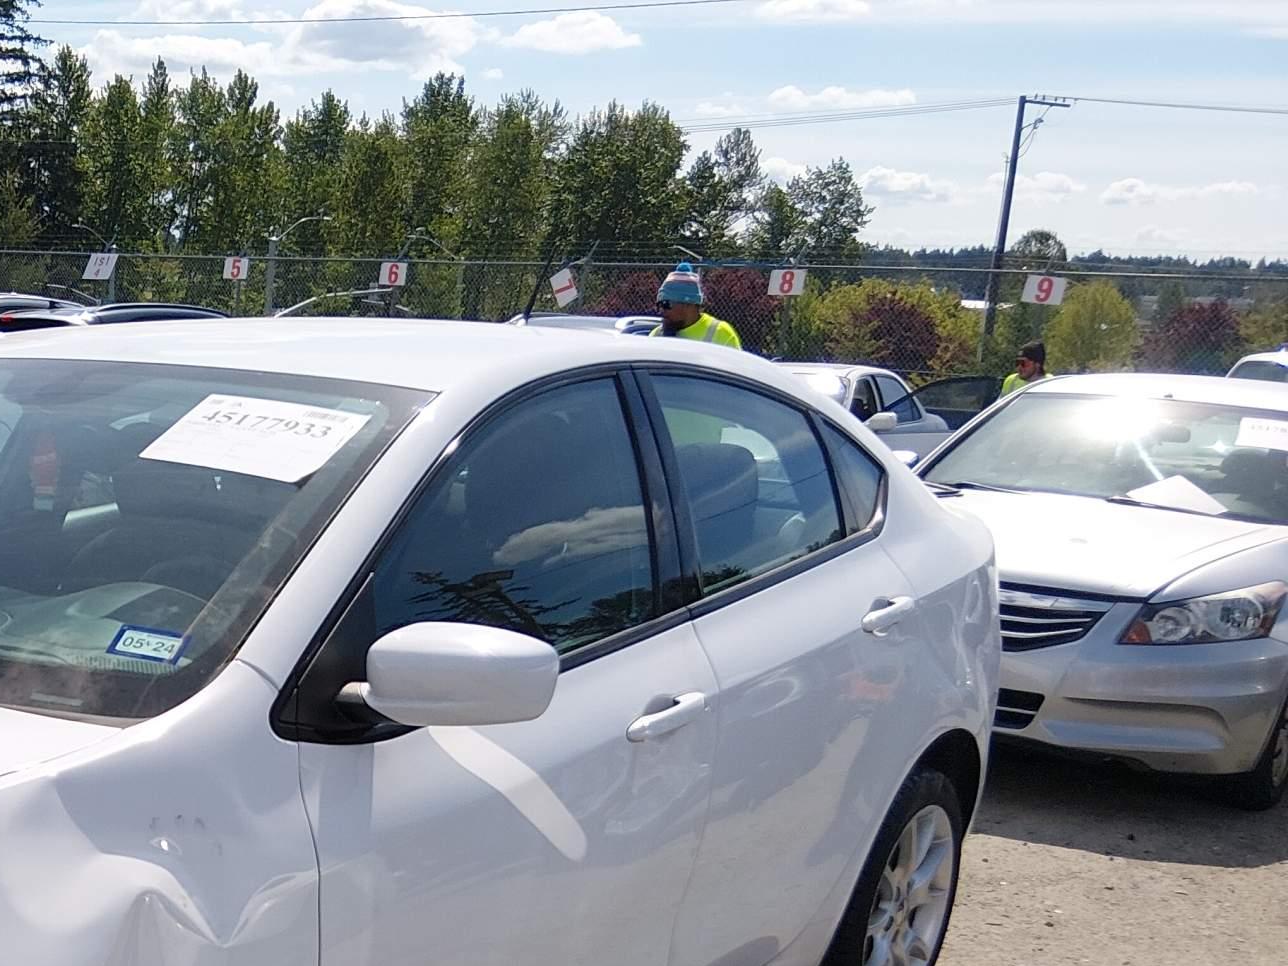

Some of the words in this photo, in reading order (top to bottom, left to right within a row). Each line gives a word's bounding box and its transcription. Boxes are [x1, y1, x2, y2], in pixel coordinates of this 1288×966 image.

[230, 258, 242, 278] 5
[387, 264, 400, 284] 6
[553, 278, 574, 296] 7
[779, 270, 796, 294] 8
[1033, 277, 1054, 303] 9
[202, 409, 333, 439] 45177933
